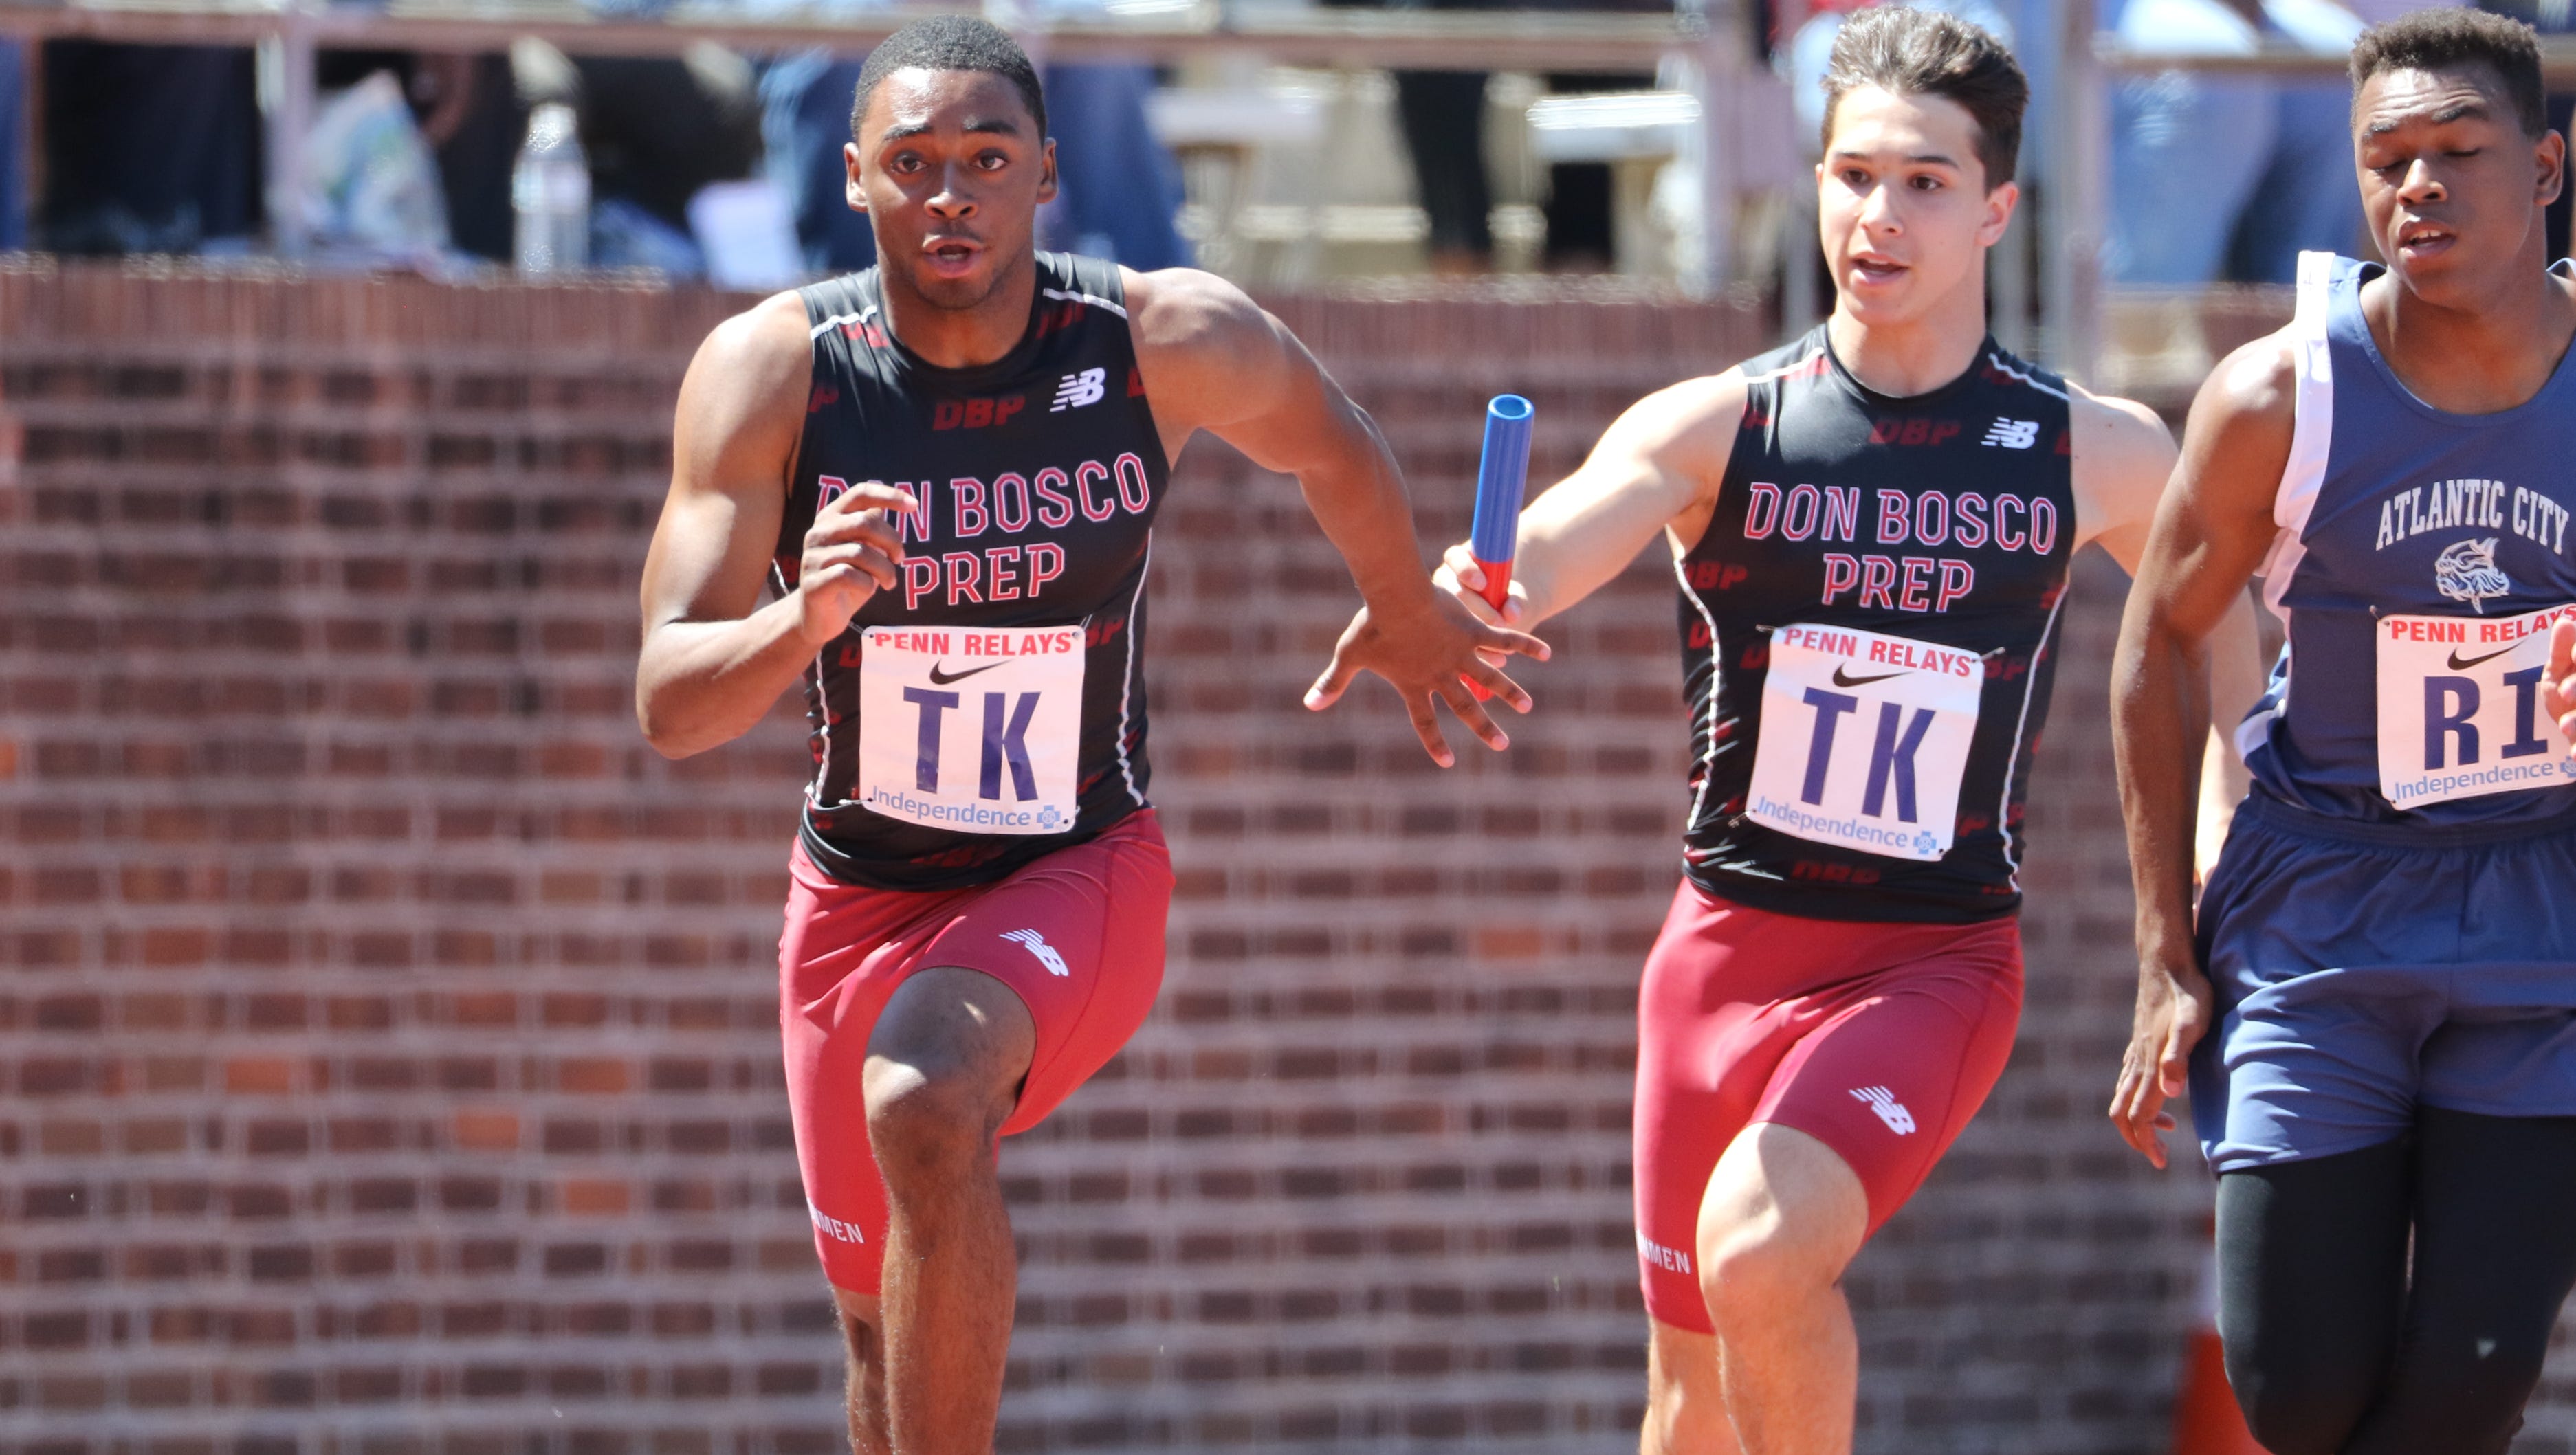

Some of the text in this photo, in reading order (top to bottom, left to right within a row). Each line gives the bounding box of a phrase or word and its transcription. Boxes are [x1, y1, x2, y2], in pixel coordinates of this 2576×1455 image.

[932, 395, 1026, 431] DBP
[1869, 418, 1961, 445] DBP
[817, 452, 1151, 544] DN BOSCO
[1743, 482, 2058, 555] DON BOSCO
[2375, 478, 2570, 555] ATLANTIC CITY
[901, 542, 1066, 610] PREP
[1822, 553, 1974, 613] PREP
[874, 632, 1072, 656] PENN RELAYS
[1783, 627, 1974, 678] PENN RELAYS
[2391, 620, 2465, 643] PENN
[903, 685, 1042, 802] TK
[2423, 665, 2549, 771] RI
[1801, 686, 1937, 824] TK
[2395, 759, 2554, 801] Independence
[872, 786, 1031, 827] Independence
[1757, 795, 1908, 849] Independence
